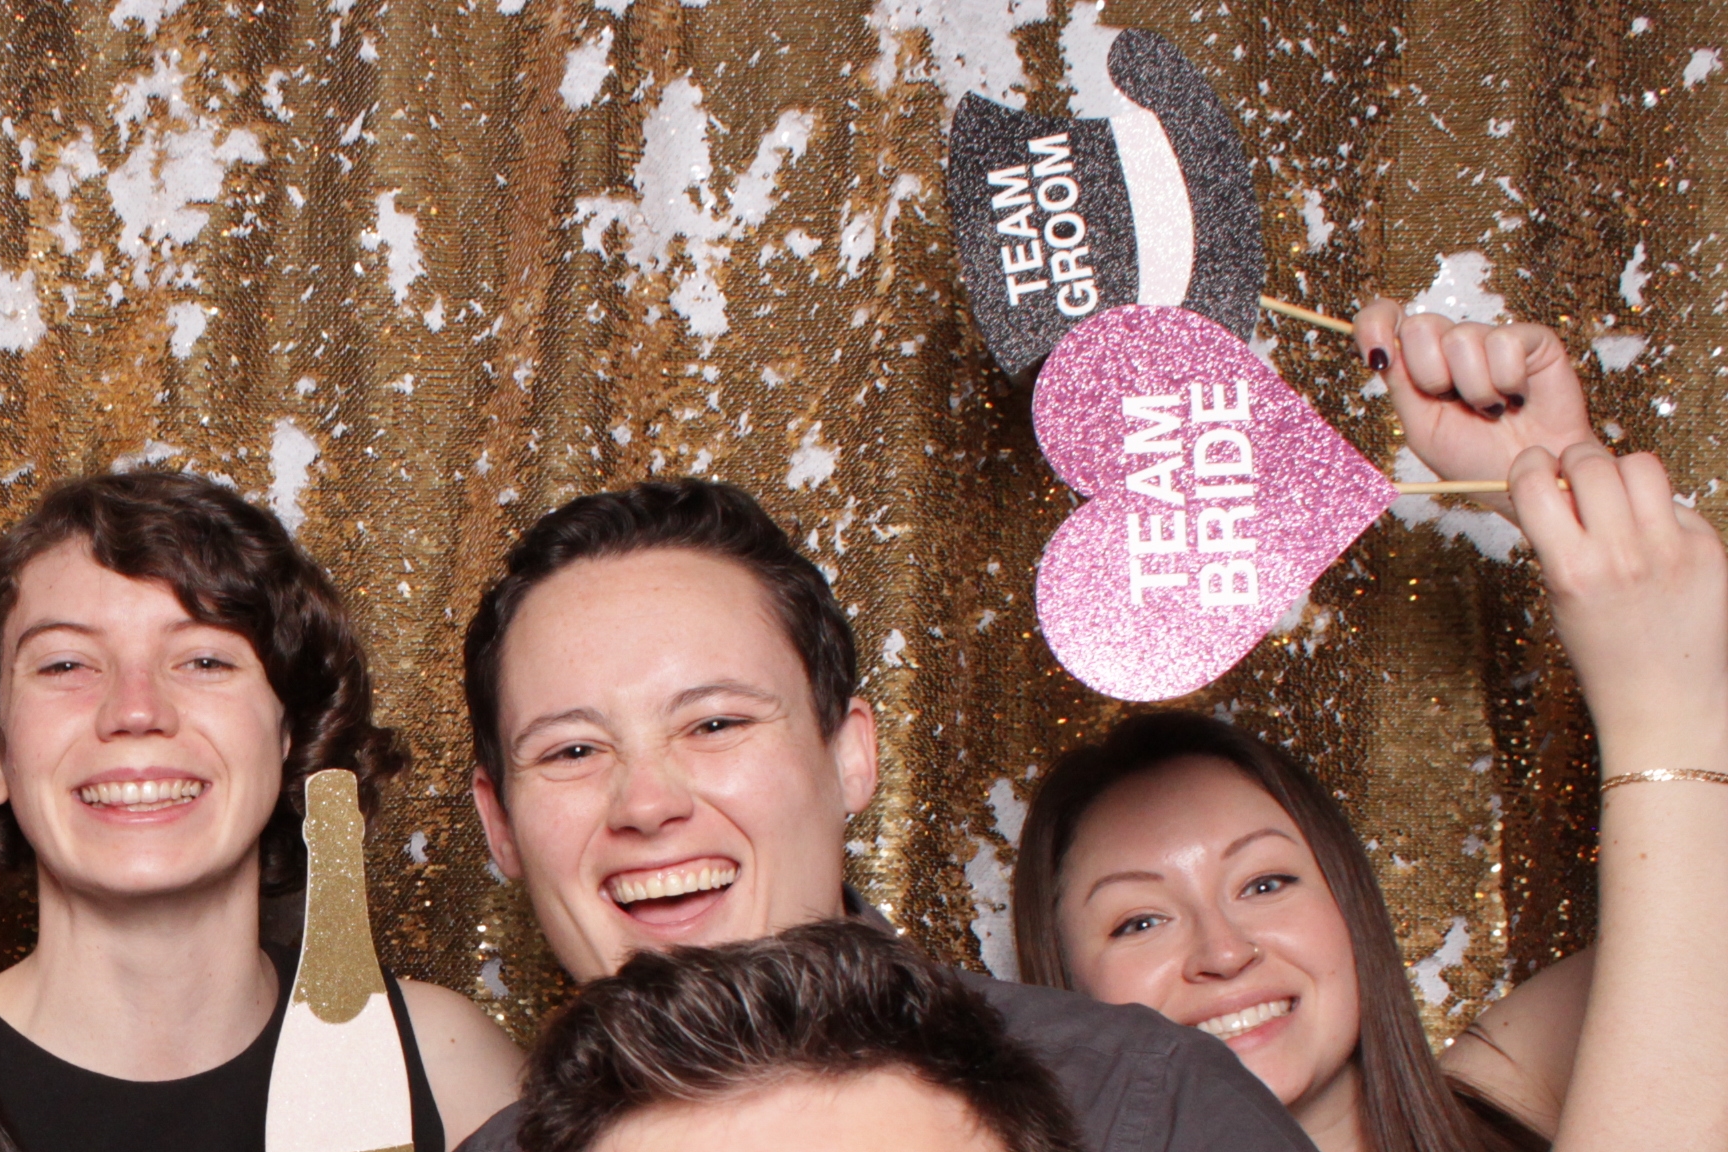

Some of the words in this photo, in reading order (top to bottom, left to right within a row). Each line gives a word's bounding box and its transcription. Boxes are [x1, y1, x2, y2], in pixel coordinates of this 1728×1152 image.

[987, 166, 1047, 305] TEAM
[1028, 132, 1098, 317] GROOM
[1123, 397, 1187, 604] TEAM
[1191, 381, 1259, 607] BRIDE
